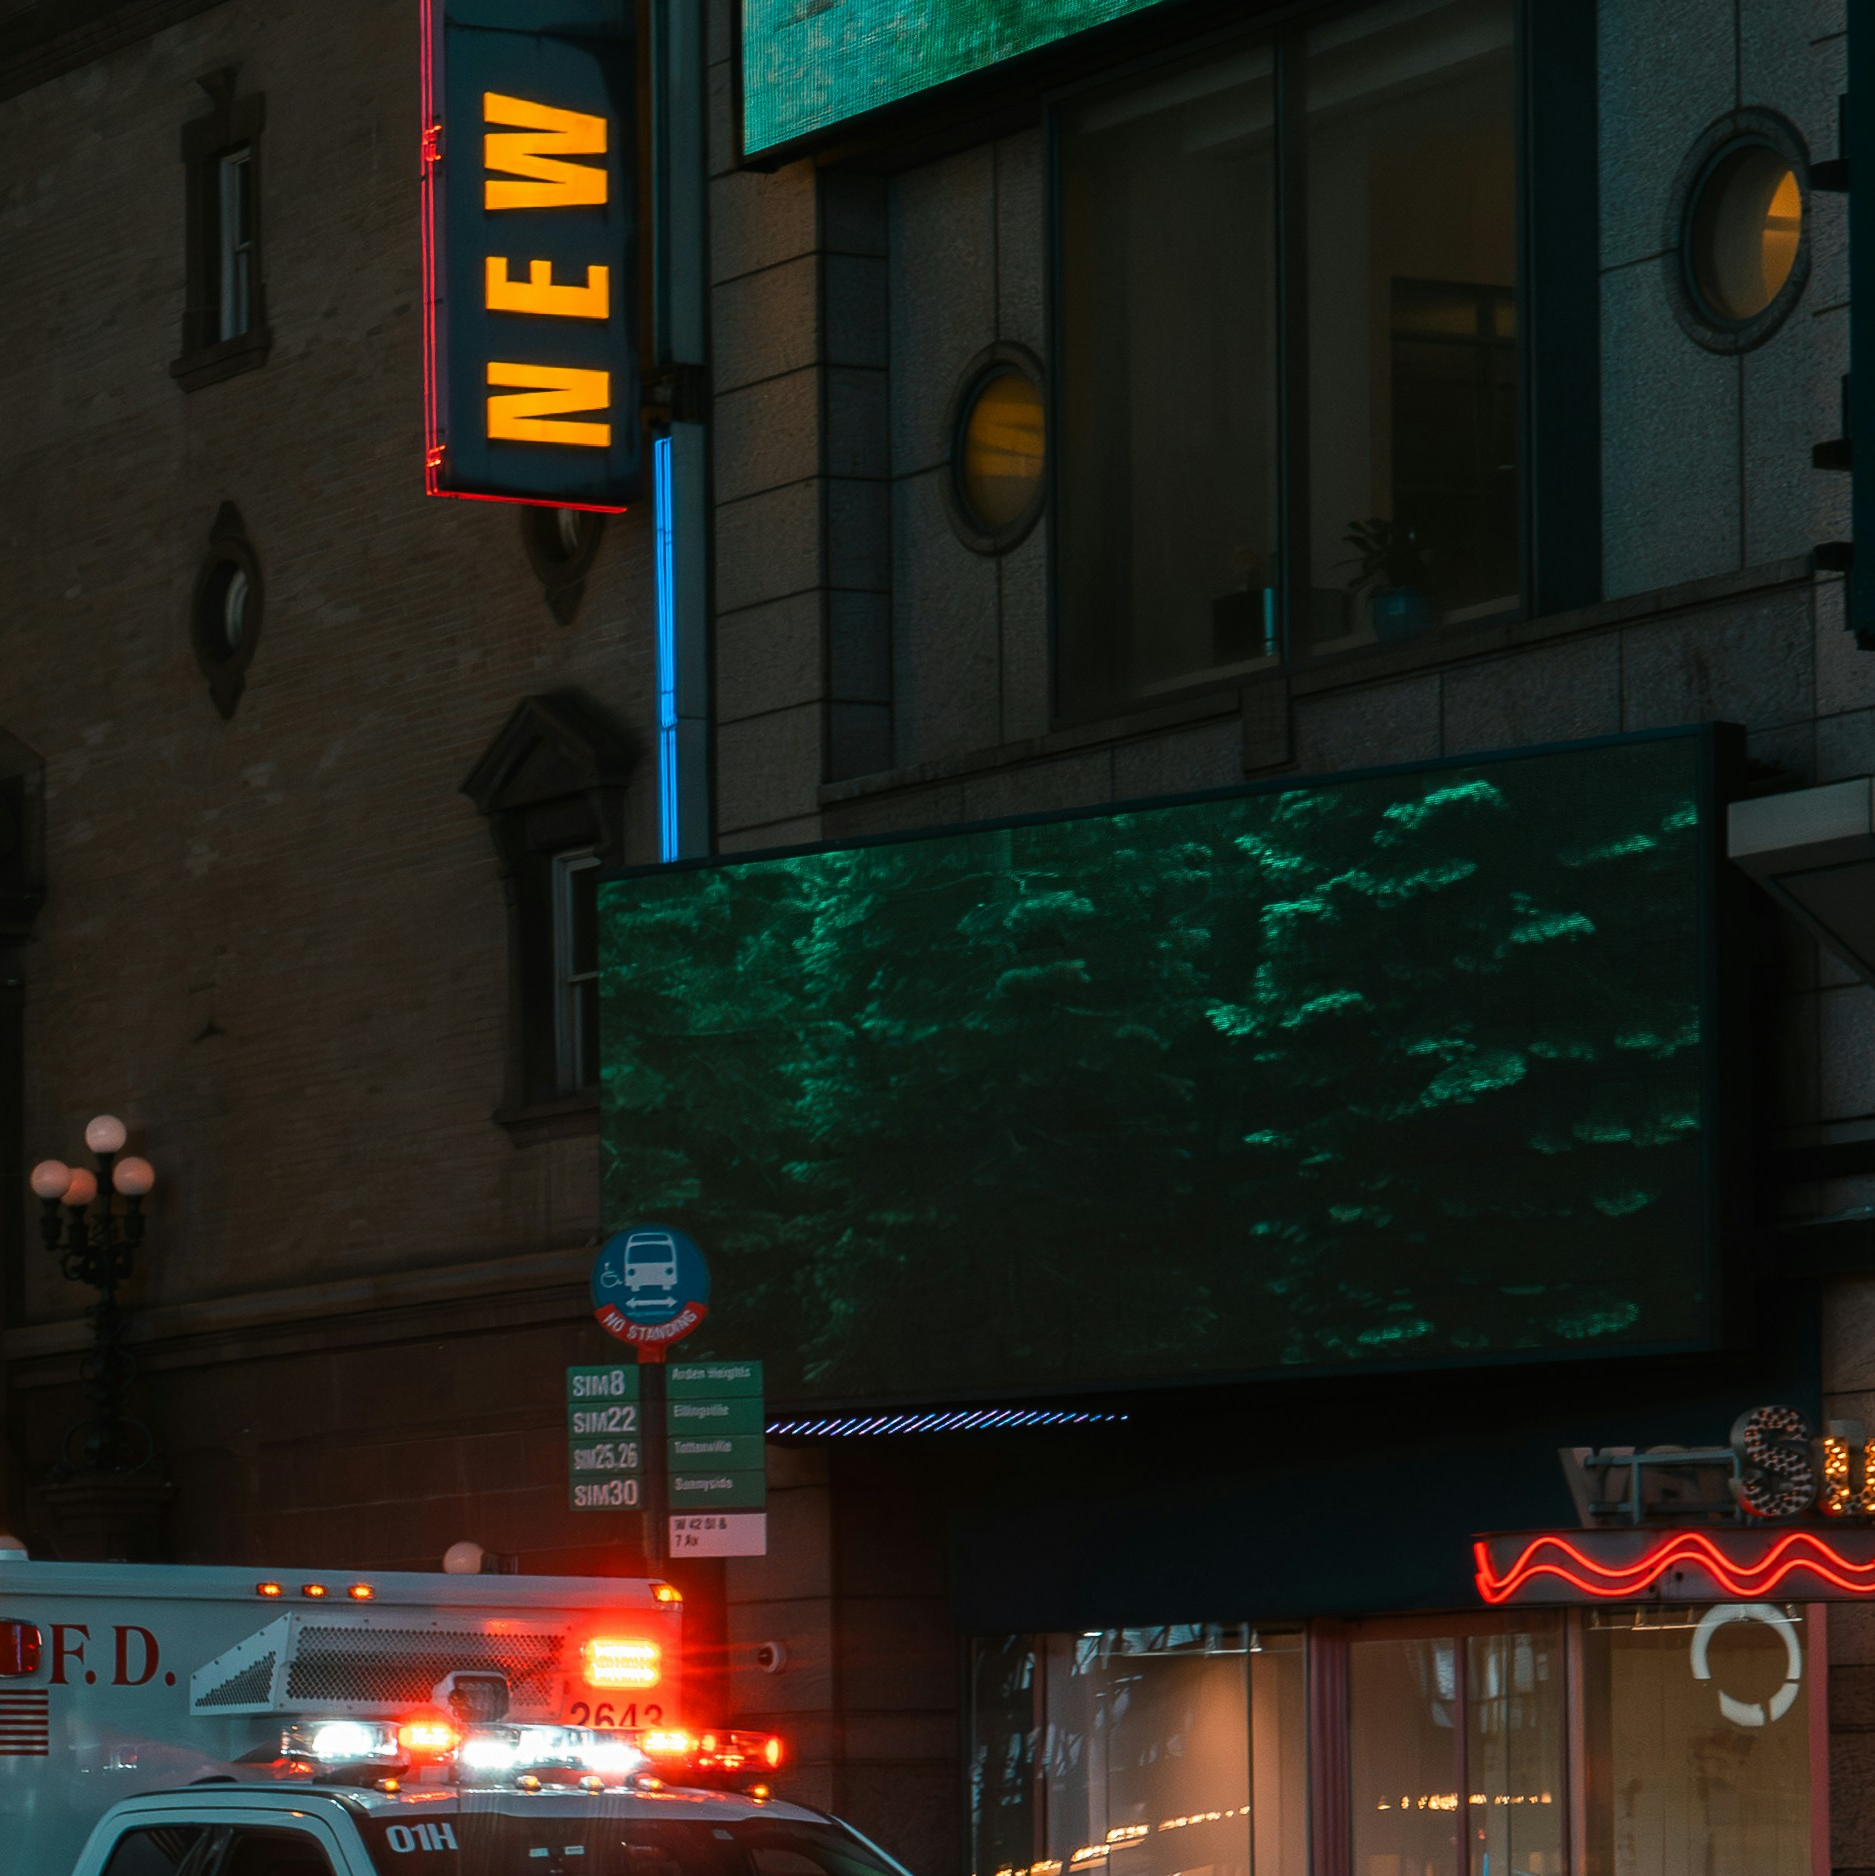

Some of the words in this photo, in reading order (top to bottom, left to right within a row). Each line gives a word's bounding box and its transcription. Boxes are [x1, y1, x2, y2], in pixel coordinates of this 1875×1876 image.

[483, 91, 612, 448] NEW
[603, 1311, 627, 1333] NO
[626, 1309, 698, 1342] STANDING
[572, 1369, 625, 1397] SIM8
[572, 1406, 637, 1433] SIM22
[574, 1479, 639, 1507] SIM30
[49, 1624, 176, 1686] F.D.
[570, 1702, 663, 1727] 2643
